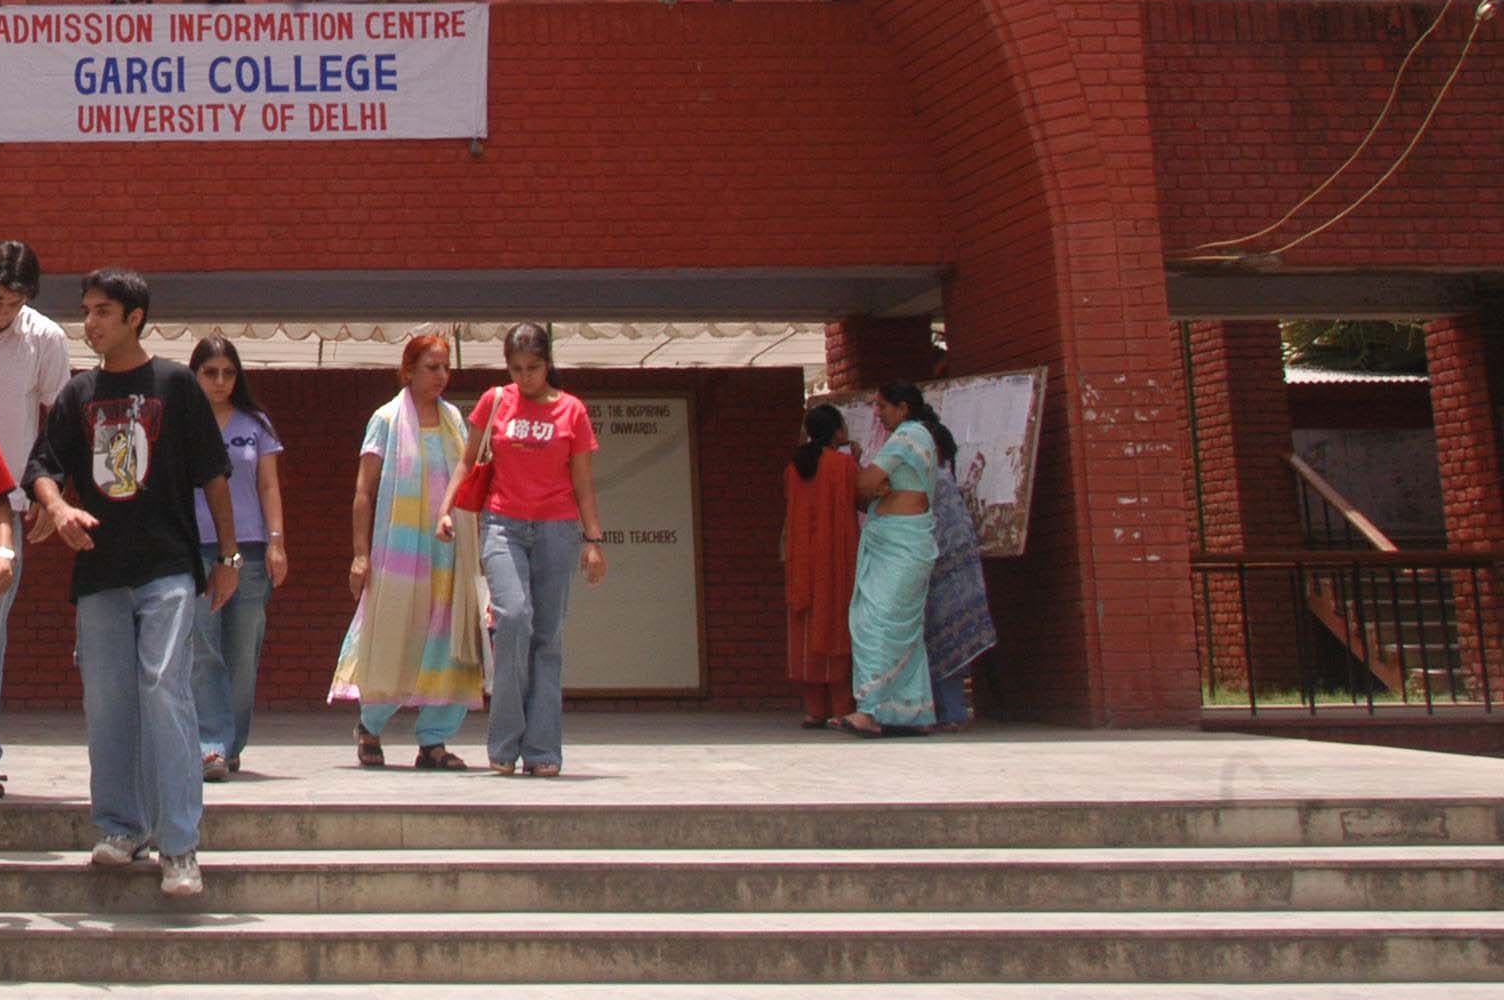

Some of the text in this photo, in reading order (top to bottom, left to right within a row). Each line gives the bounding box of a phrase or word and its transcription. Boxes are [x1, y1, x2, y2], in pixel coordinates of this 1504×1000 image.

[170, 11, 353, 42] INFORMATION
[365, 10, 466, 39] CENTRE
[74, 54, 398, 95] GARGI COLLEGE
[78, 103, 387, 134] UNIVERSITY OF DELHI
[630, 529, 678, 544] TEACHERS
